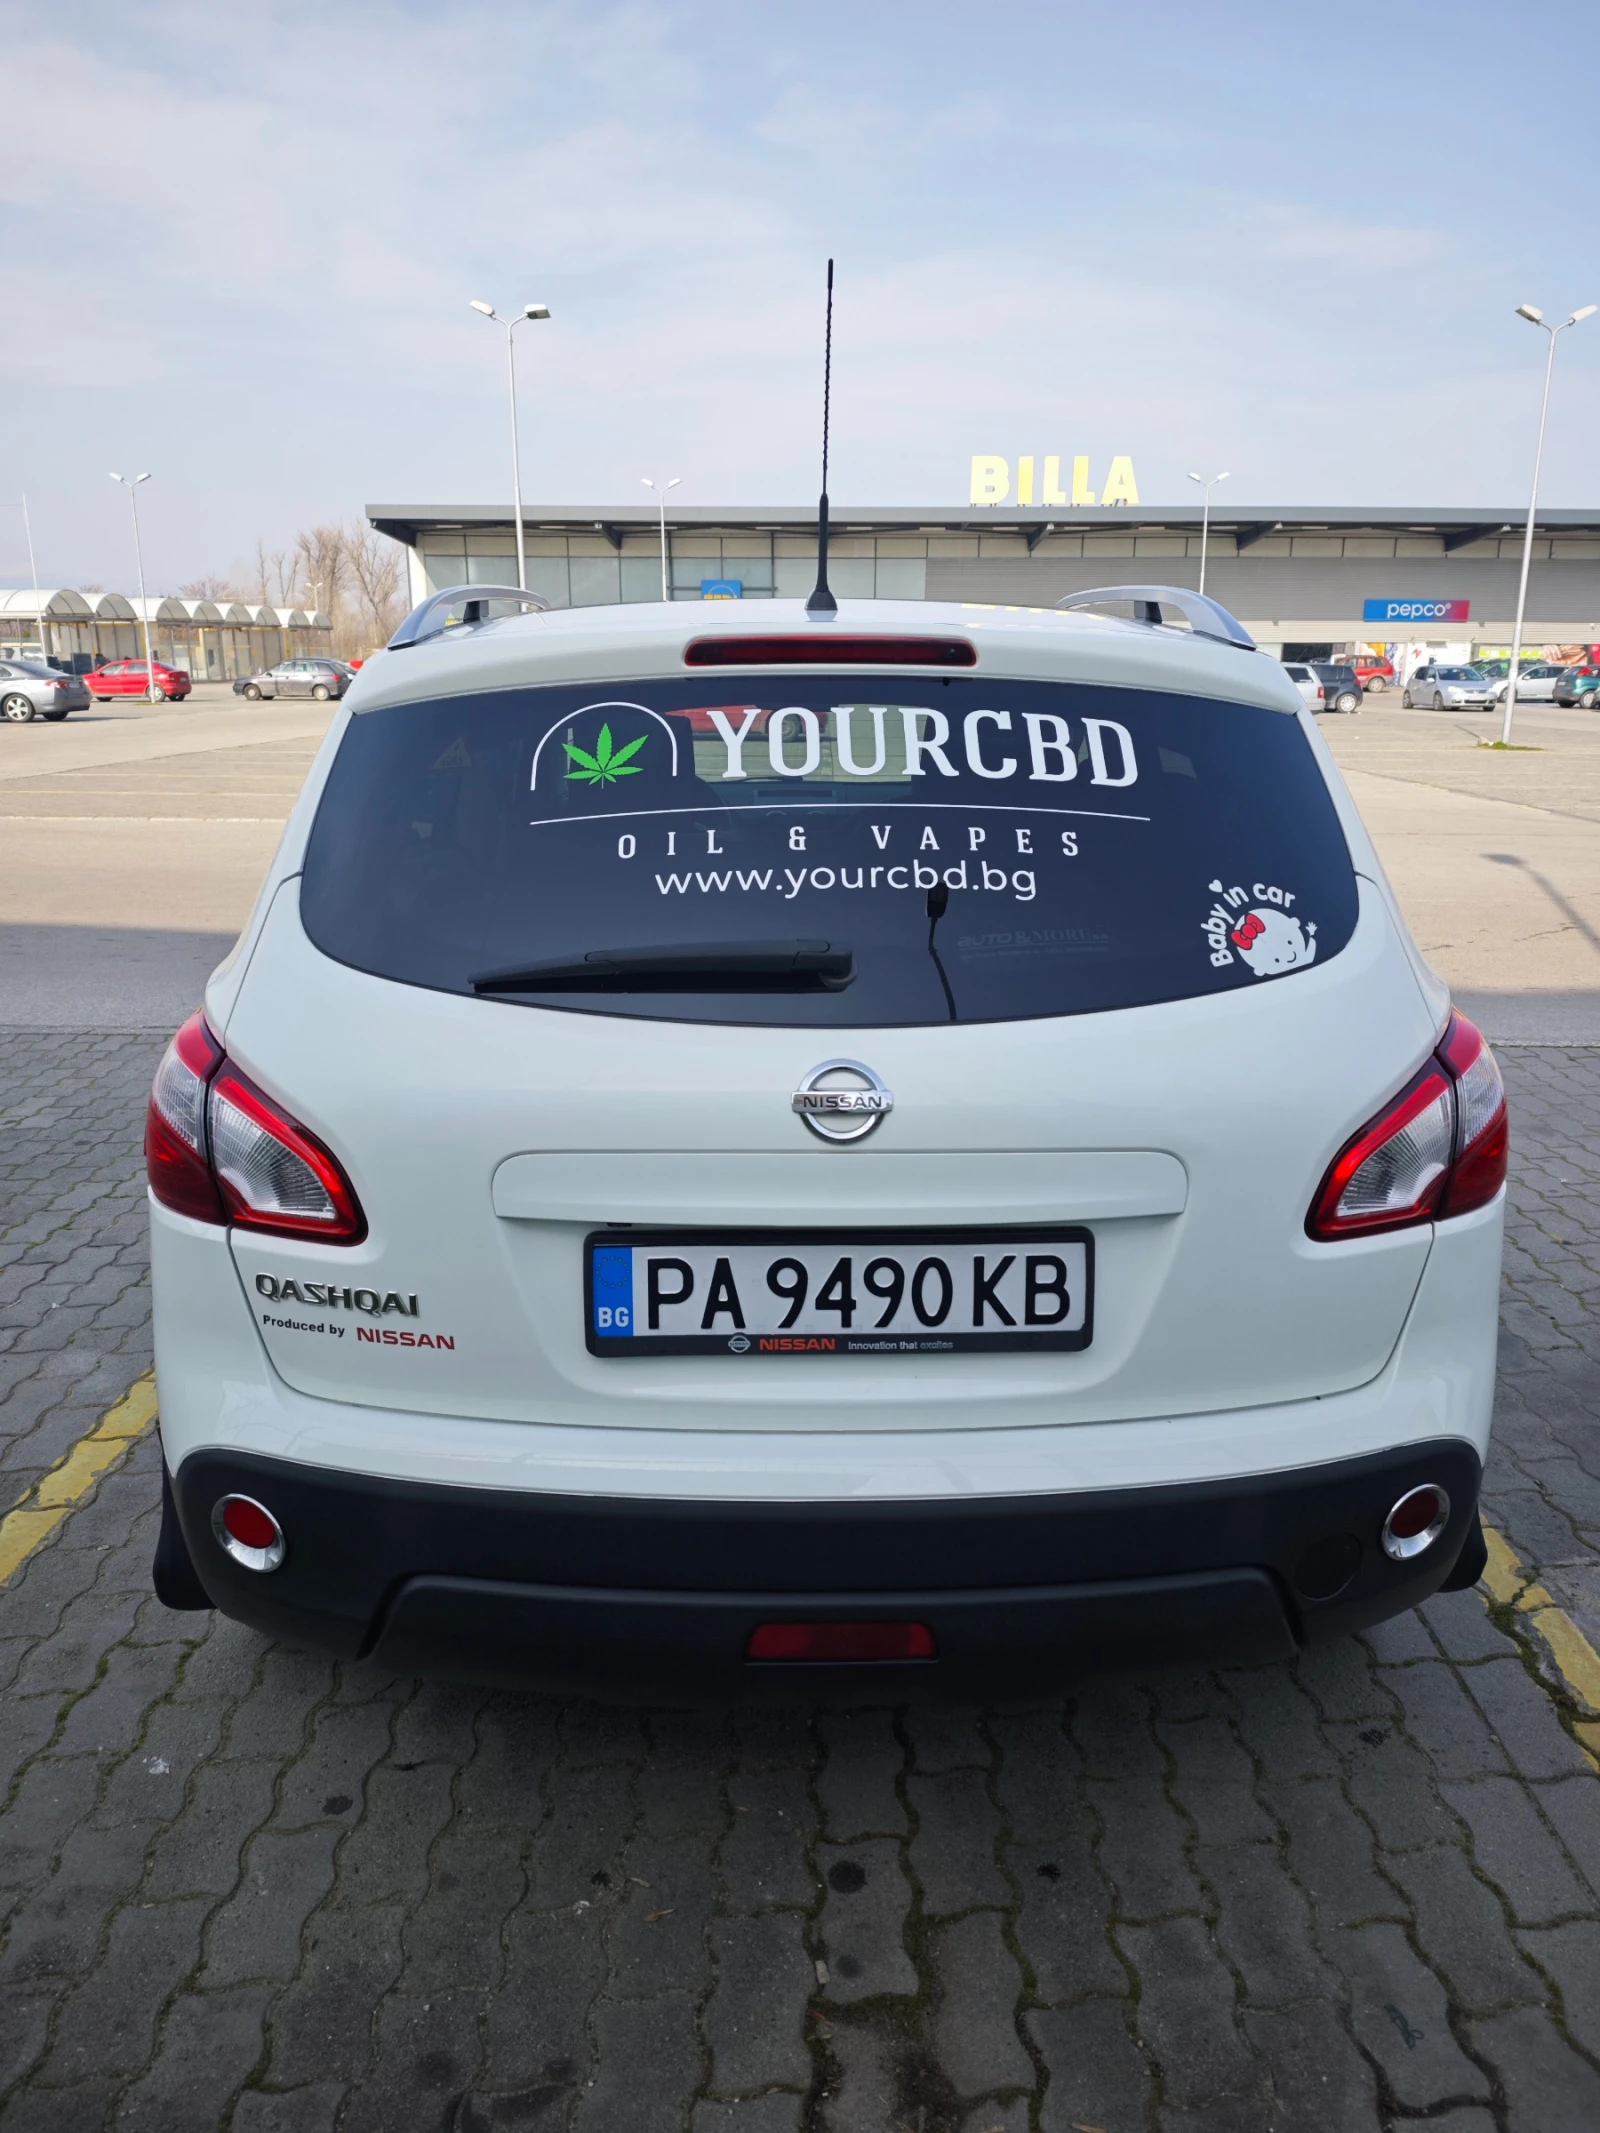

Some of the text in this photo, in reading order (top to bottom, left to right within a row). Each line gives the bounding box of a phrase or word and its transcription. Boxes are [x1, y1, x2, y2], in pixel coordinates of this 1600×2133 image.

[970, 455, 1139, 504] BILLA
[1387, 602, 1446, 619] pepco
[706, 706, 1140, 787] YOURCBD
[618, 825, 1078, 859] OIL & VAPES
[655, 859, 1036, 901] www.yourcbd.bg
[1200, 883, 1296, 967] Baby in car
[803, 1096, 882, 1108] NISSAN
[255, 1272, 420, 1318] QASHQAI
[648, 1255, 1071, 1329] PA 9490 KB
[263, 1314, 456, 1351] Produced by NISSAN
[598, 1307, 629, 1327] BG
[759, 1338, 836, 1351] NISSAN
[848, 1340, 898, 1350] Innovation
[899, 1340, 919, 1350] that
